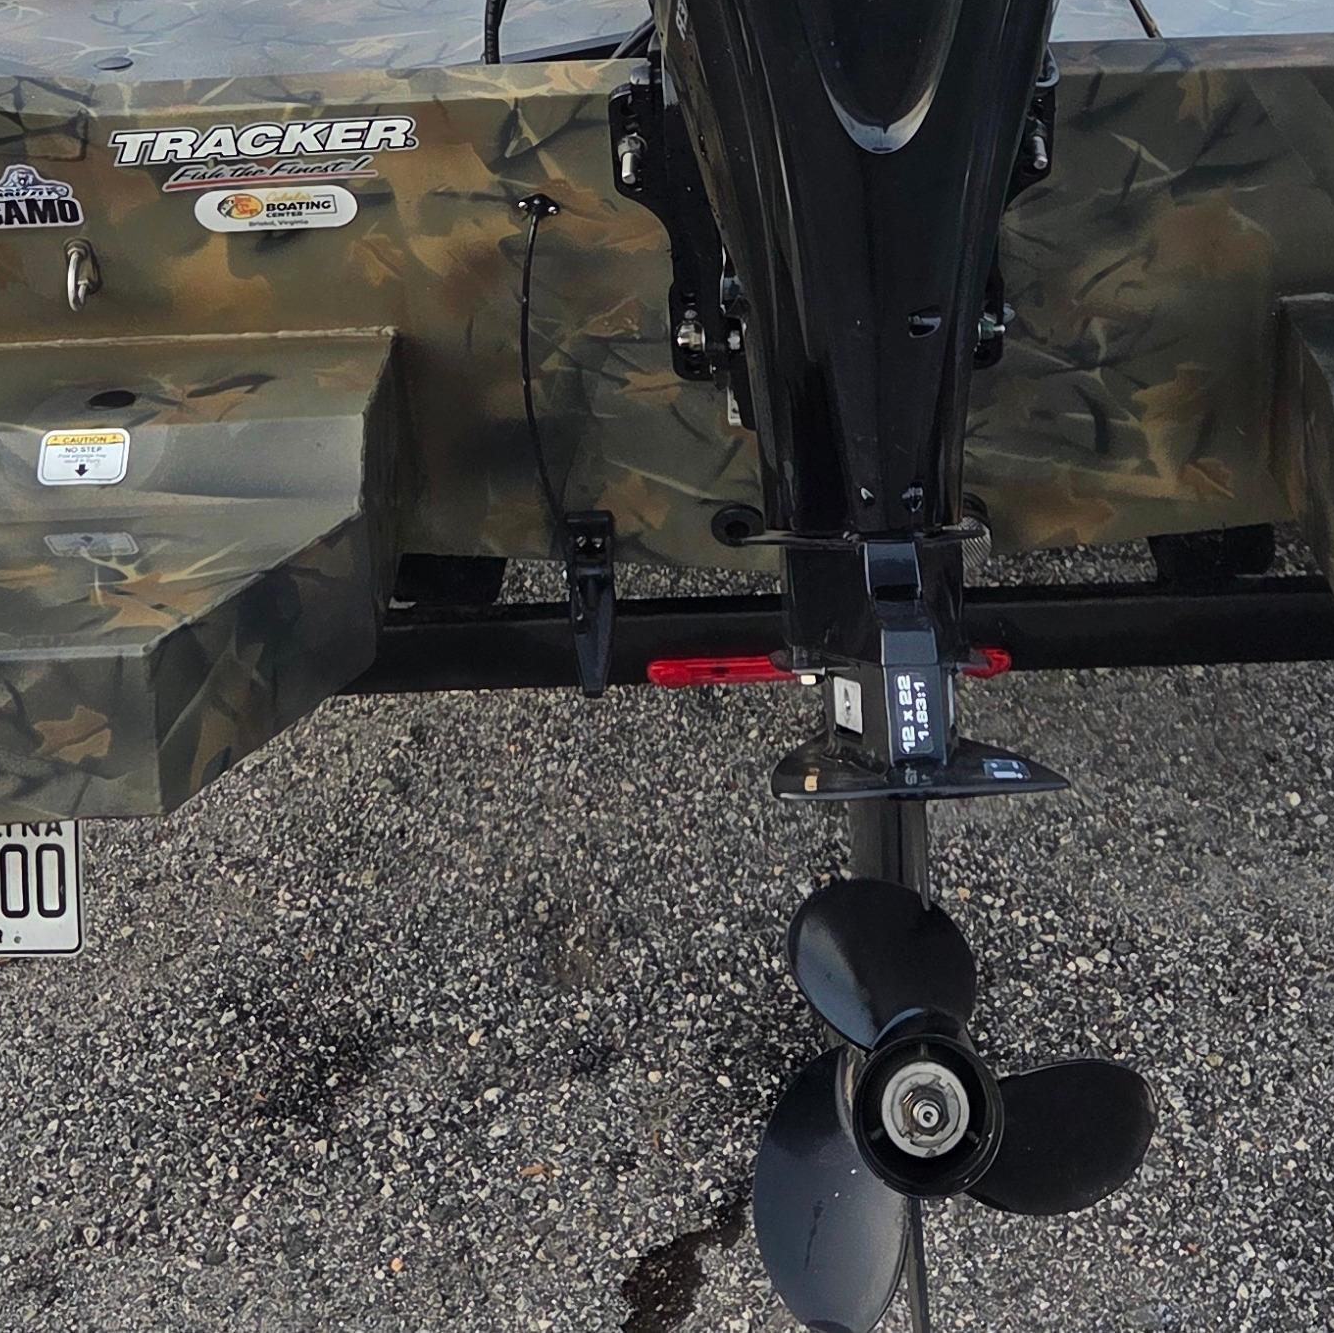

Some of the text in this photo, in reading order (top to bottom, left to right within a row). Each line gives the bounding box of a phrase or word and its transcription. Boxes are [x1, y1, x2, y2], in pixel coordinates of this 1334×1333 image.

[172, 166, 225, 182] Fish
[229, 164, 265, 179] the
[266, 200, 332, 212] BOATING
[62, 436, 107, 444] CAUTION
[913, 681, 930, 742] 1.83:1
